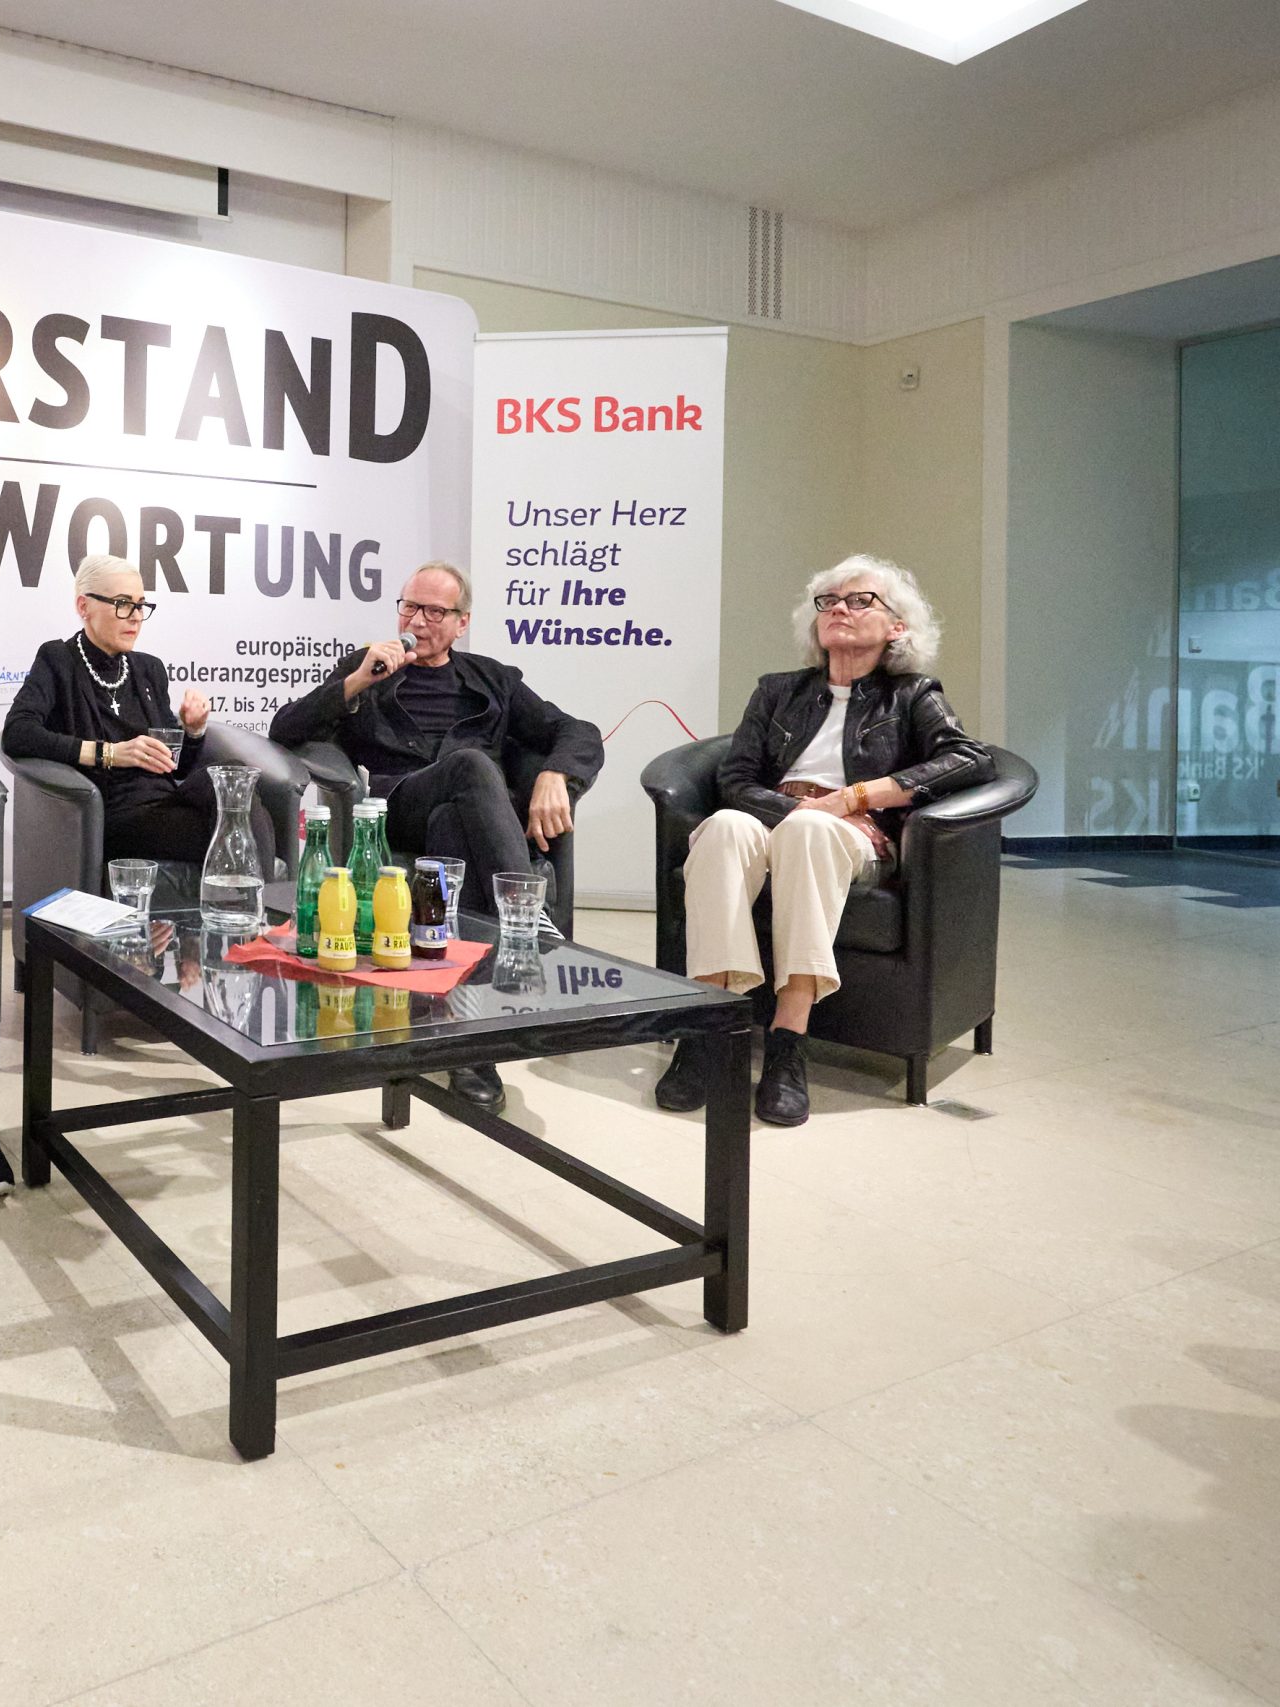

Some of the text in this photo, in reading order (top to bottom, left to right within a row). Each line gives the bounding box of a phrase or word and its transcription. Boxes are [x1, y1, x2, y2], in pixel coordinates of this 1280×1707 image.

[496, 394, 703, 434] BKS Bank
[507, 499, 687, 527] Unser Herz
[505, 540, 622, 573] schlägt
[505, 579, 627, 606] für Ihre
[504, 618, 673, 647] Wünsche.
[235, 636, 356, 662] europäische
[166, 661, 337, 688] toleranzgespräc
[208, 696, 228, 712] 17.
[234, 696, 255, 713] bis
[334, 942, 355, 951] RAUC
